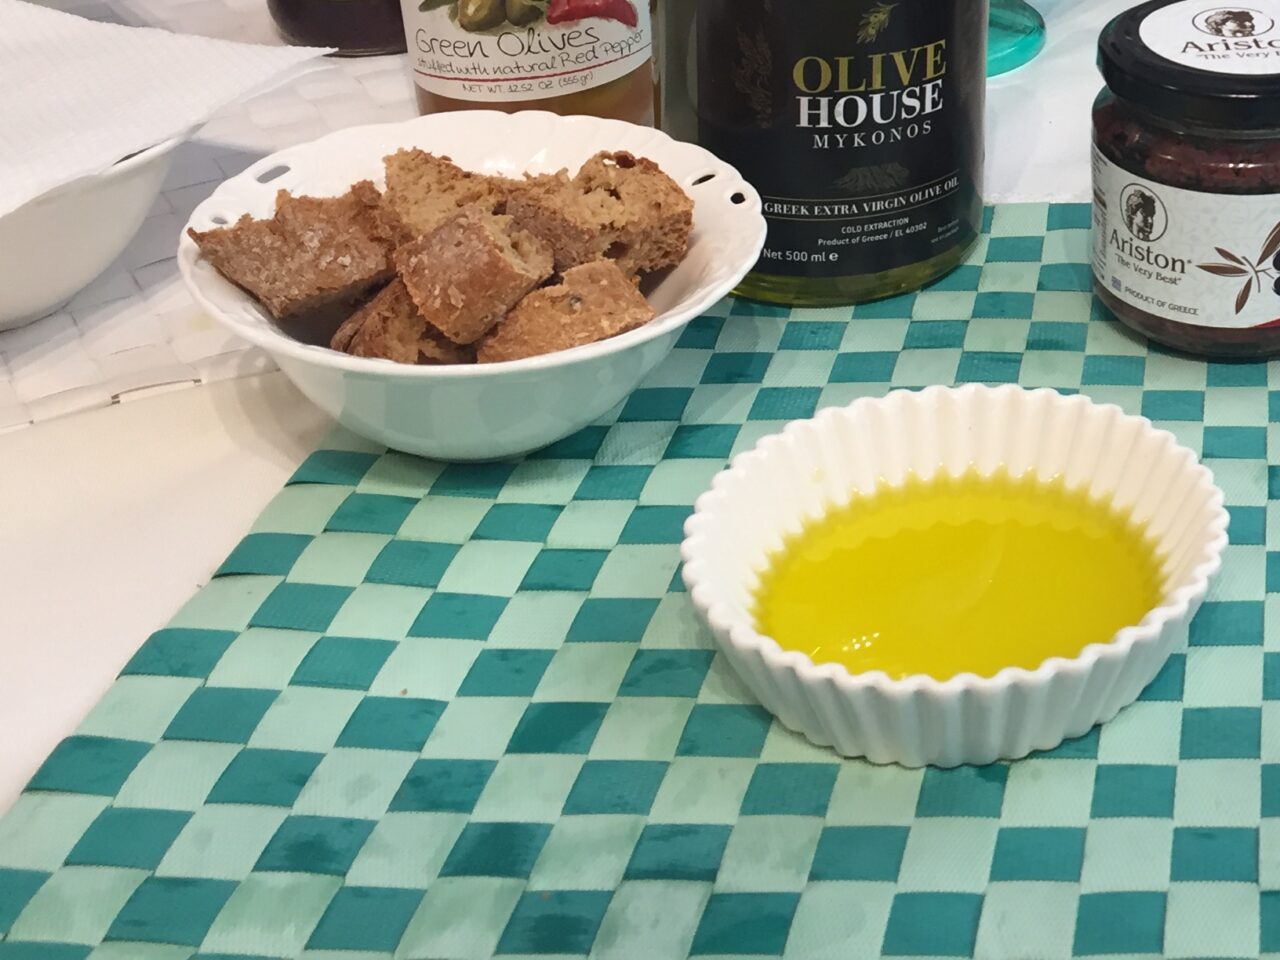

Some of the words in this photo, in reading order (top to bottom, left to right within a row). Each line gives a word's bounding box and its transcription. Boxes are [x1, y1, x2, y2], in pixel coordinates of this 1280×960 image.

[415, 28, 489, 59] Green
[497, 26, 600, 56] Olives
[560, 45, 598, 65] Red
[792, 38, 947, 94] OLIVE
[795, 78, 944, 128] HOUSE
[812, 120, 932, 150] MYKONOS
[764, 202, 810, 215] GREEK
[814, 204, 858, 216] EXTRA
[863, 196, 907, 213] VIRGIN
[910, 185, 942, 204] OLIVE
[944, 176, 959, 191] OIL
[818, 237, 849, 246] Product
[851, 236, 860, 244] of
[862, 233, 888, 243] Greece
[841, 224, 862, 234] COLD
[864, 217, 909, 232] EXTRACTION
[763, 248, 783, 260] Net
[786, 250, 808, 262] 500
[811, 251, 826, 262] ml
[1110, 229, 1186, 274] Ariston
[1133, 263, 1153, 279] Very
[1124, 286, 1155, 305] PRODUCT
[1157, 300, 1167, 308] OF
[1168, 303, 1199, 316] GREECE
